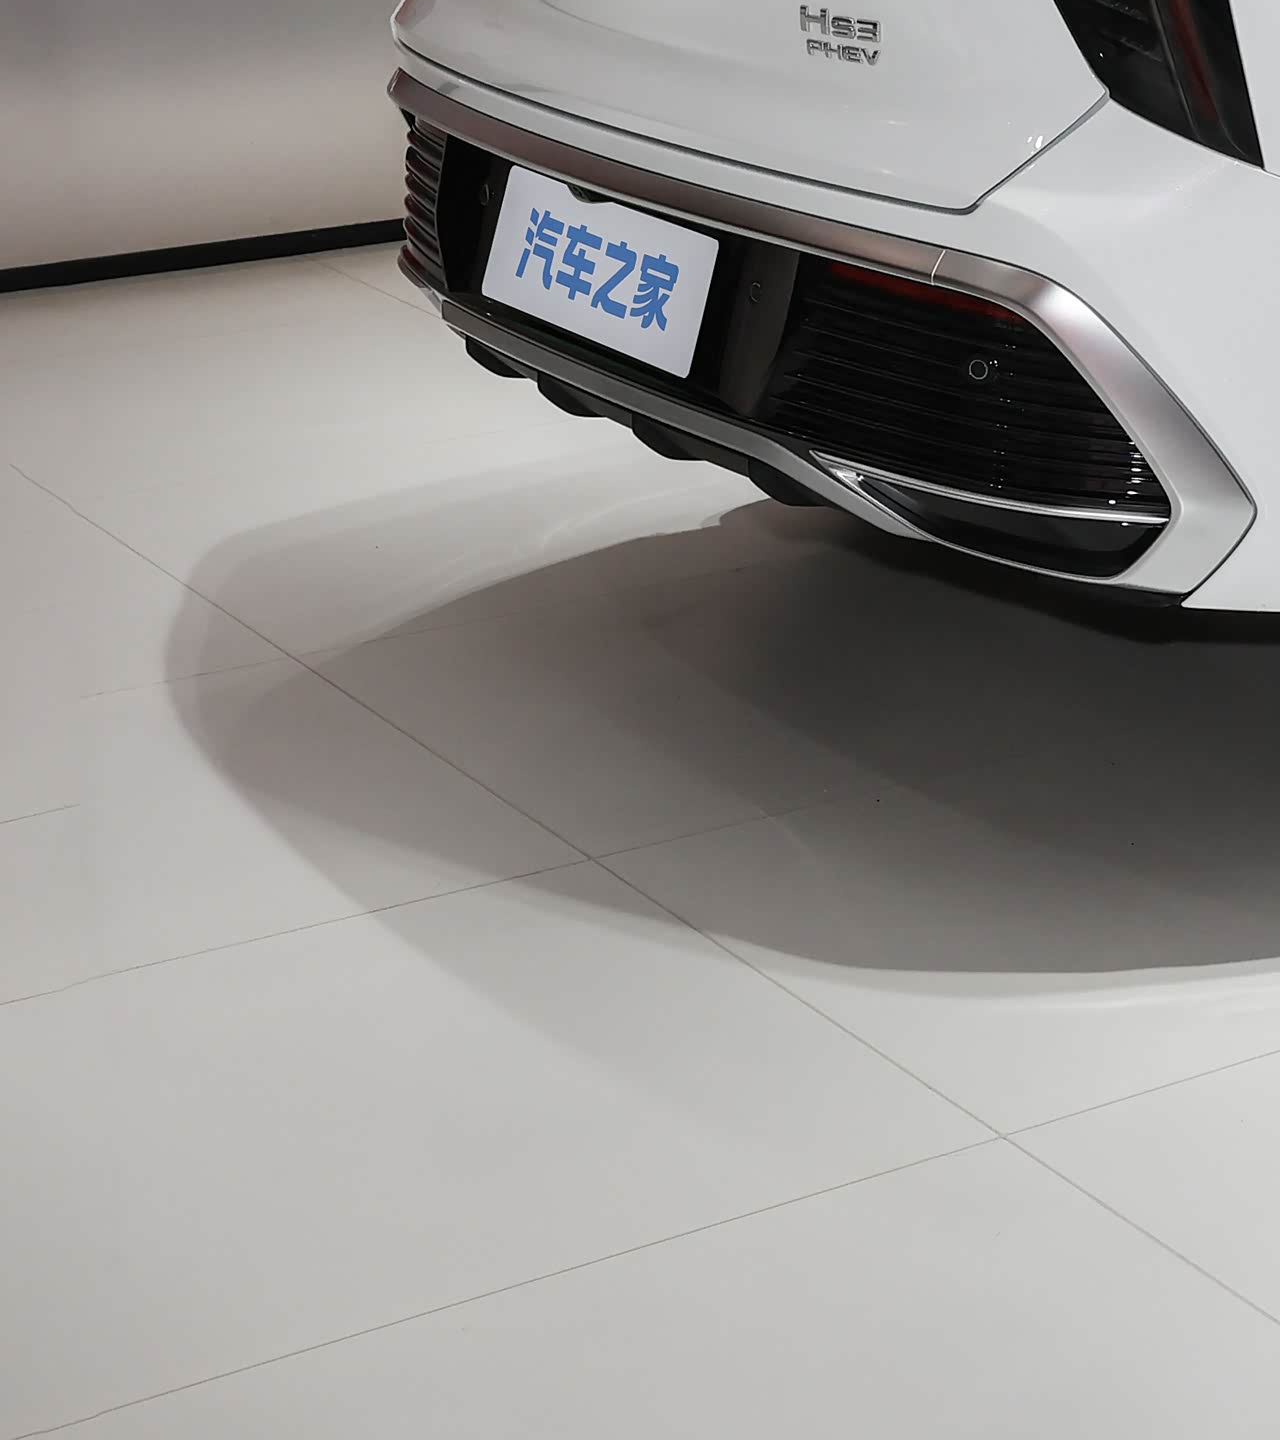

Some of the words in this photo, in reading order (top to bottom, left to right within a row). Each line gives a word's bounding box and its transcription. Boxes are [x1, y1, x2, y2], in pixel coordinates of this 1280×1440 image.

[806, 38, 881, 66] PHEV
[515, 207, 679, 332] 汽车之家
